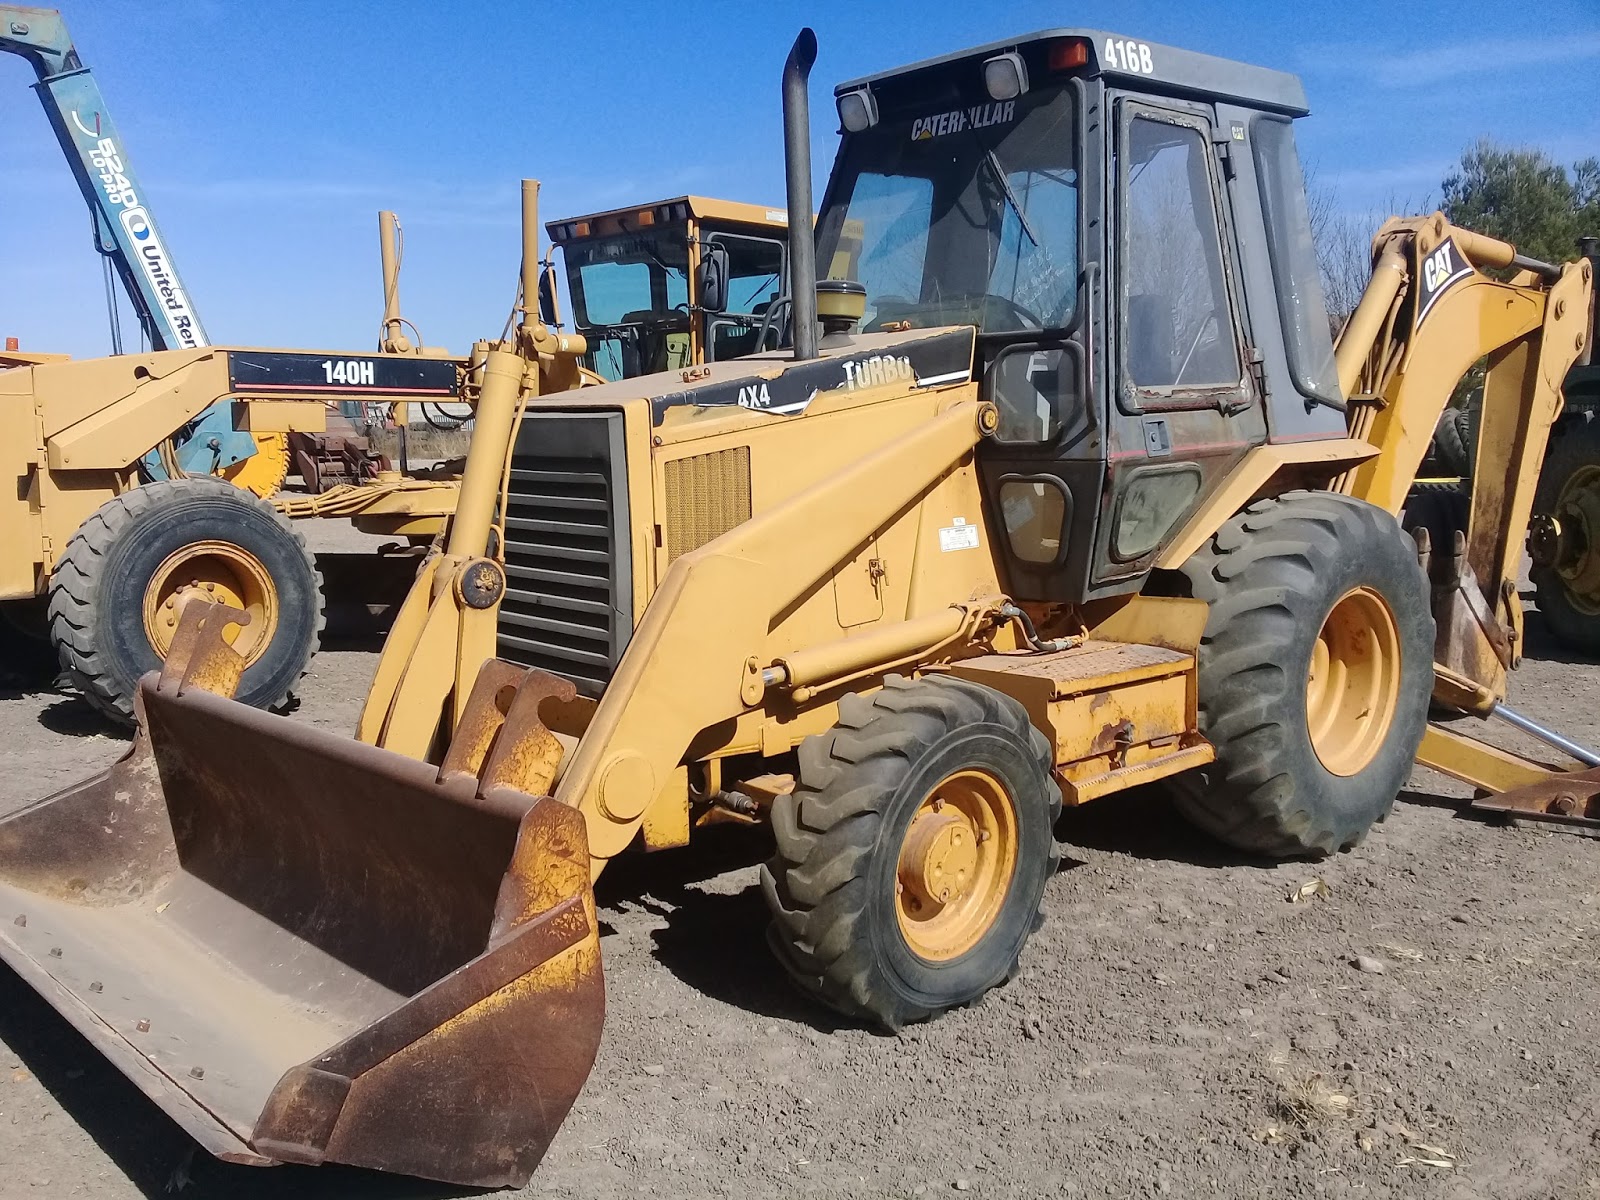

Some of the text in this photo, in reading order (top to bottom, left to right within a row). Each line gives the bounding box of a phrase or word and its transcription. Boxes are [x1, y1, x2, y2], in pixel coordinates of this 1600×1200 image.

[1104, 38, 1154, 74] 416B
[911, 101, 1015, 142] CATERPILLAR
[1231, 126, 1245, 141] CAT
[88, 149, 122, 204] LO-PRO
[97, 137, 138, 208] 524D
[142, 245, 183, 310] United
[1424, 240, 1453, 293] CAT
[321, 360, 374, 385] 140H
[737, 383, 771, 408] 4X4
